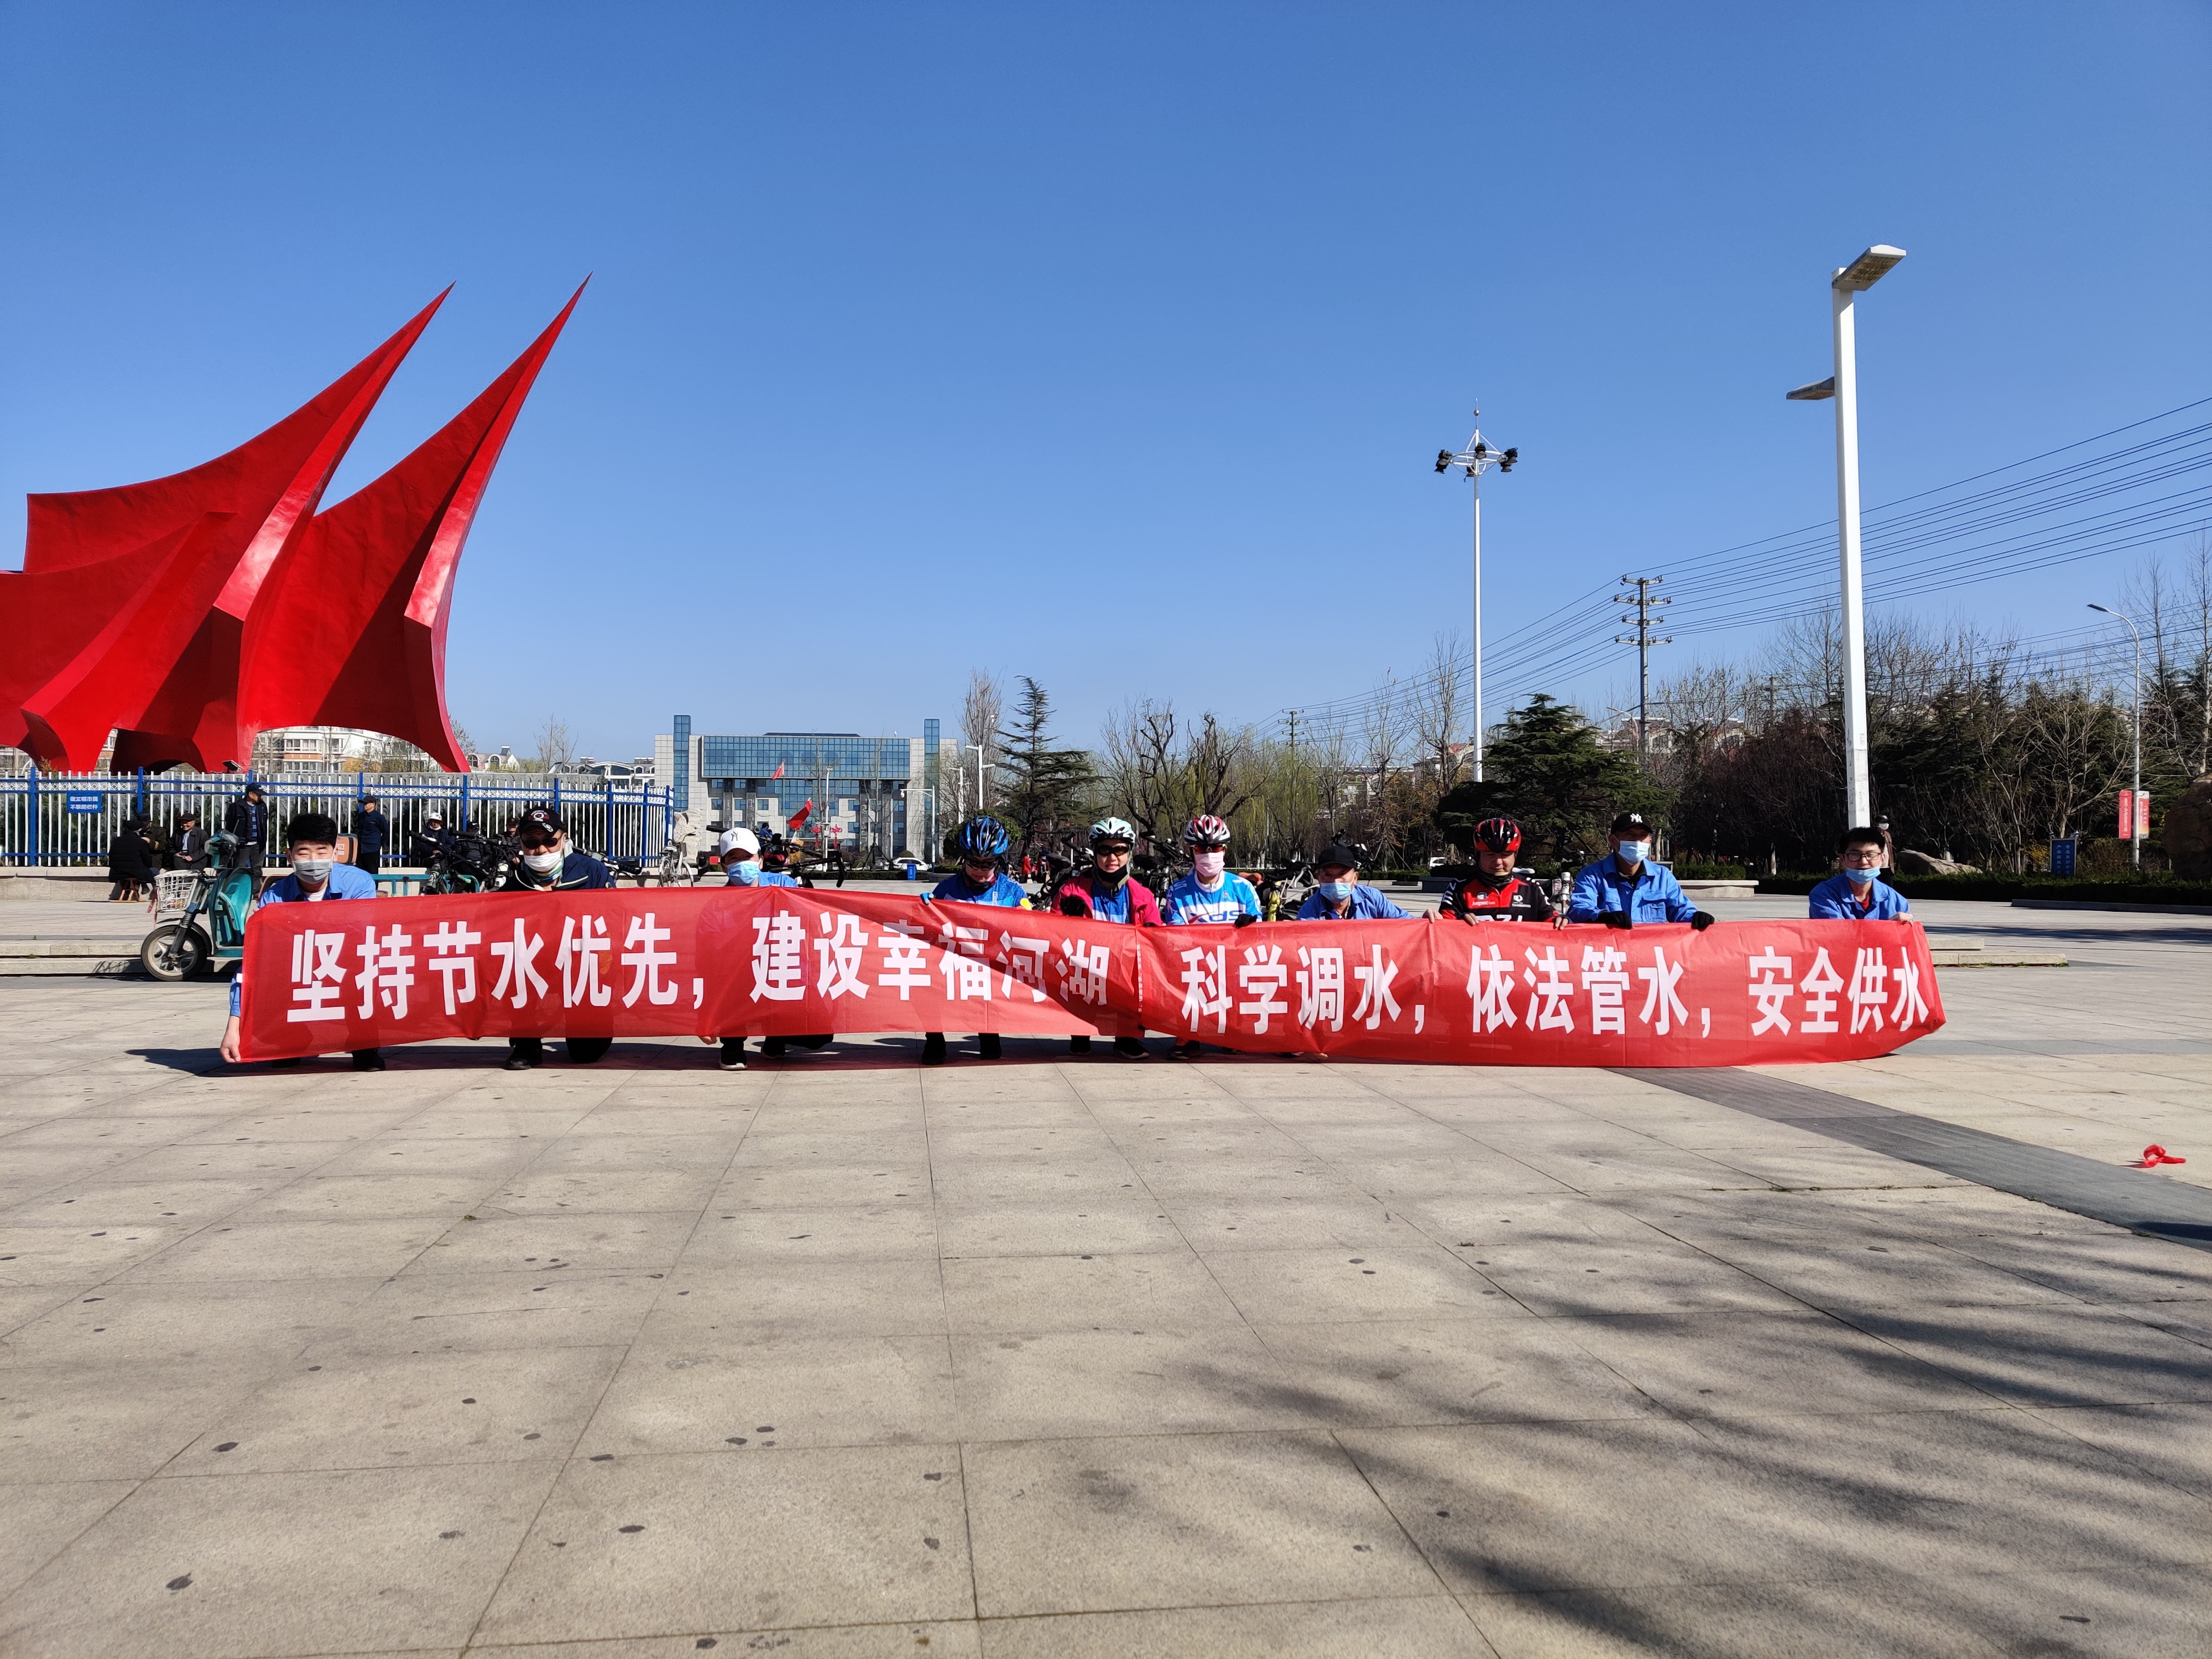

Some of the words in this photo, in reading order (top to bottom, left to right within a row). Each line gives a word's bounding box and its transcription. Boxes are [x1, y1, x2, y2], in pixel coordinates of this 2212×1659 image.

[287, 912, 704, 1022] 坚持节水优先，
[750, 910, 1110, 1005] 建设幸福河湖
[1748, 946, 1929, 1036] 安全供水
